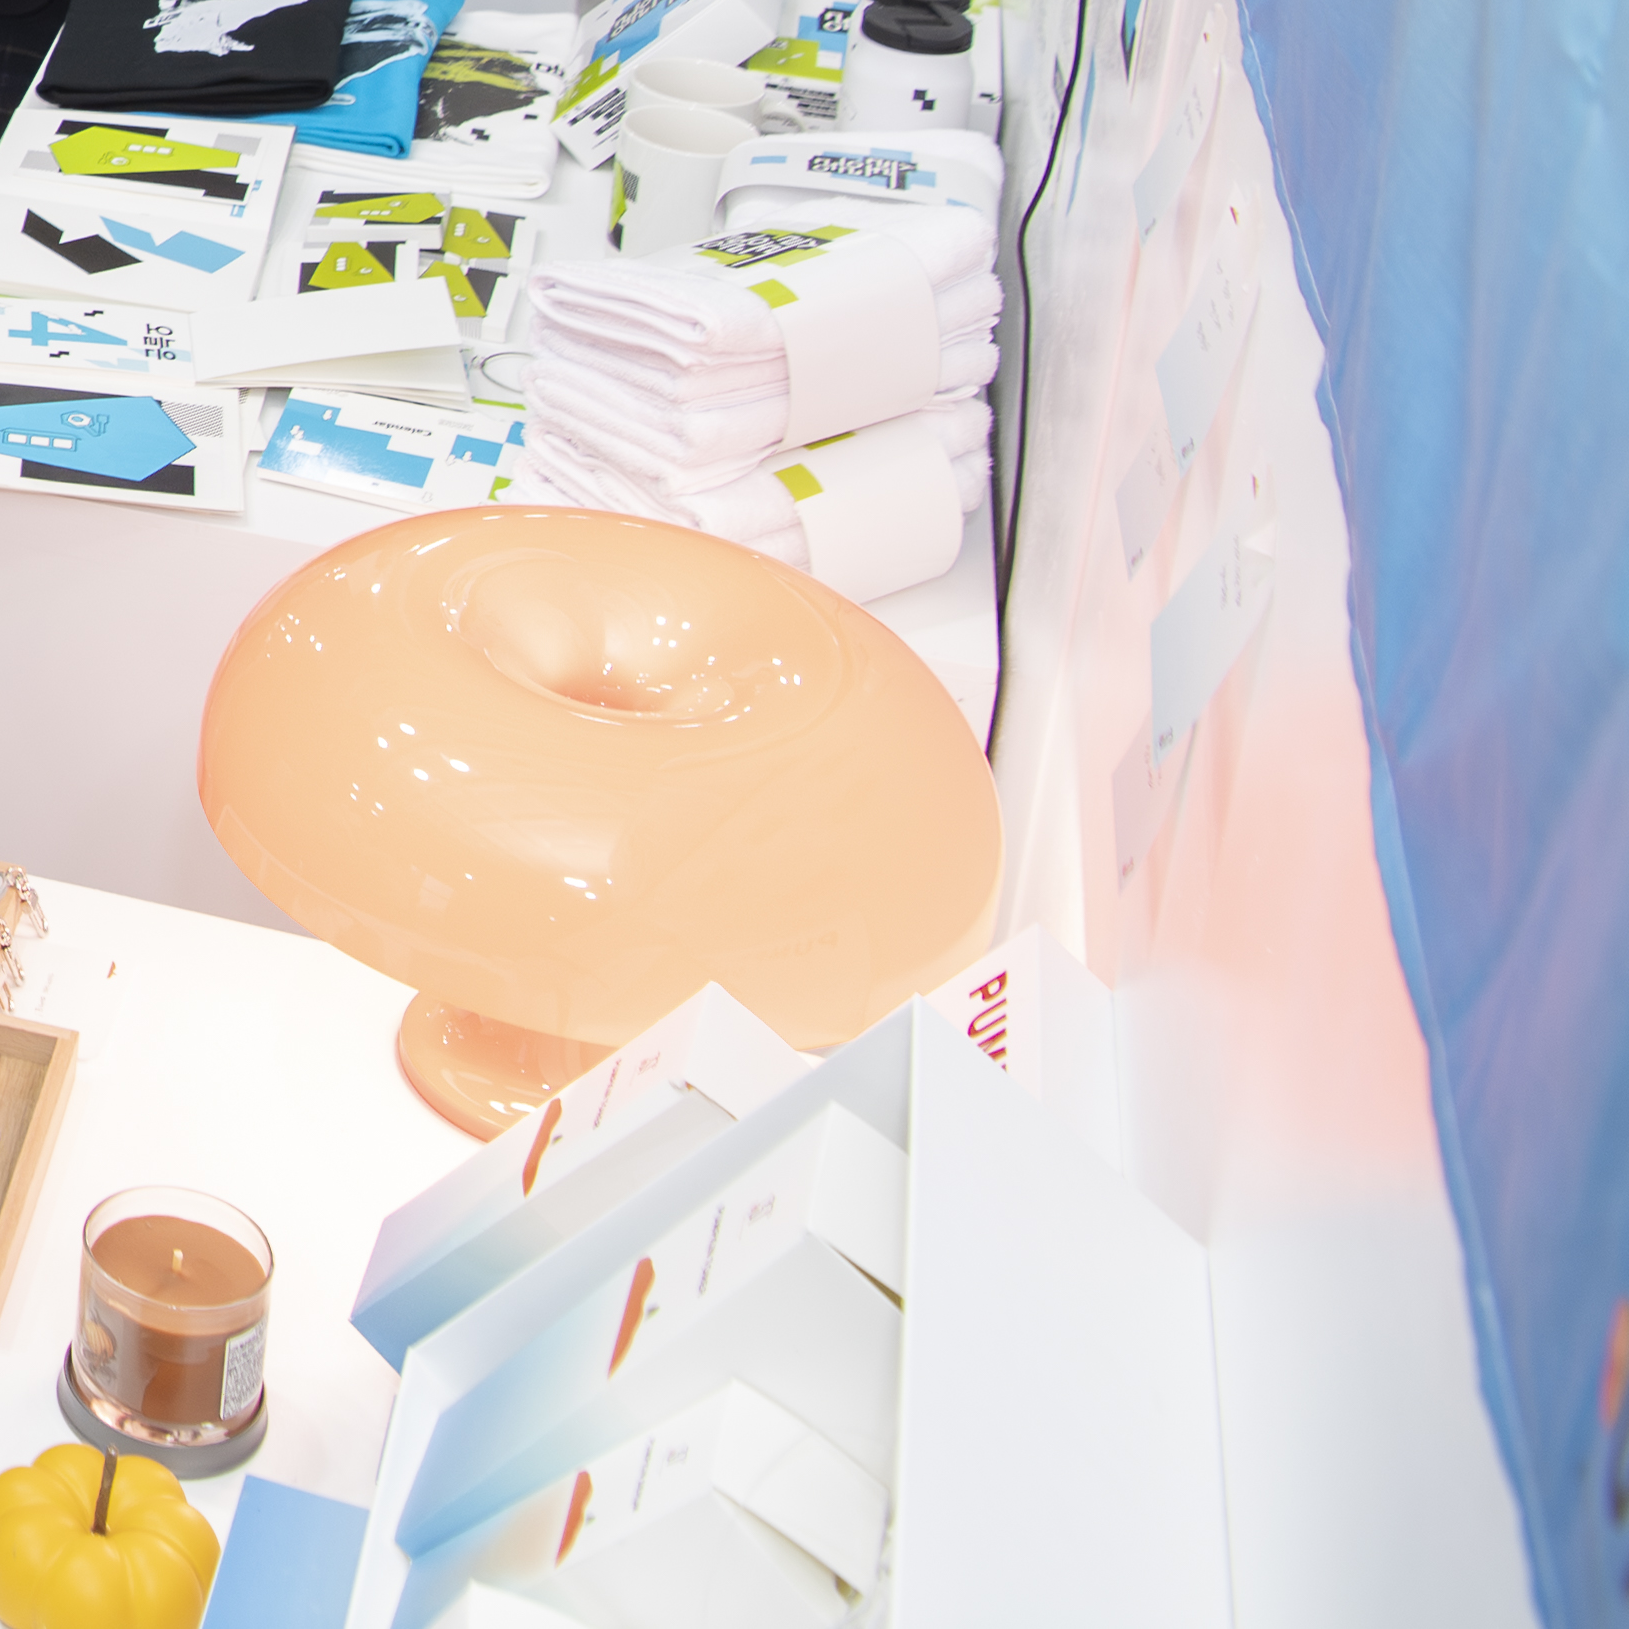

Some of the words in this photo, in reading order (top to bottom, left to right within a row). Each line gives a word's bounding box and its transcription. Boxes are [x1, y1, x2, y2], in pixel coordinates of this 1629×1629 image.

[8, 311, 128, 347] 4
[144, 323, 177, 361] 오늘은
[371, 419, 432, 438] Calendar
[967, 970, 1008, 1072] PUM
